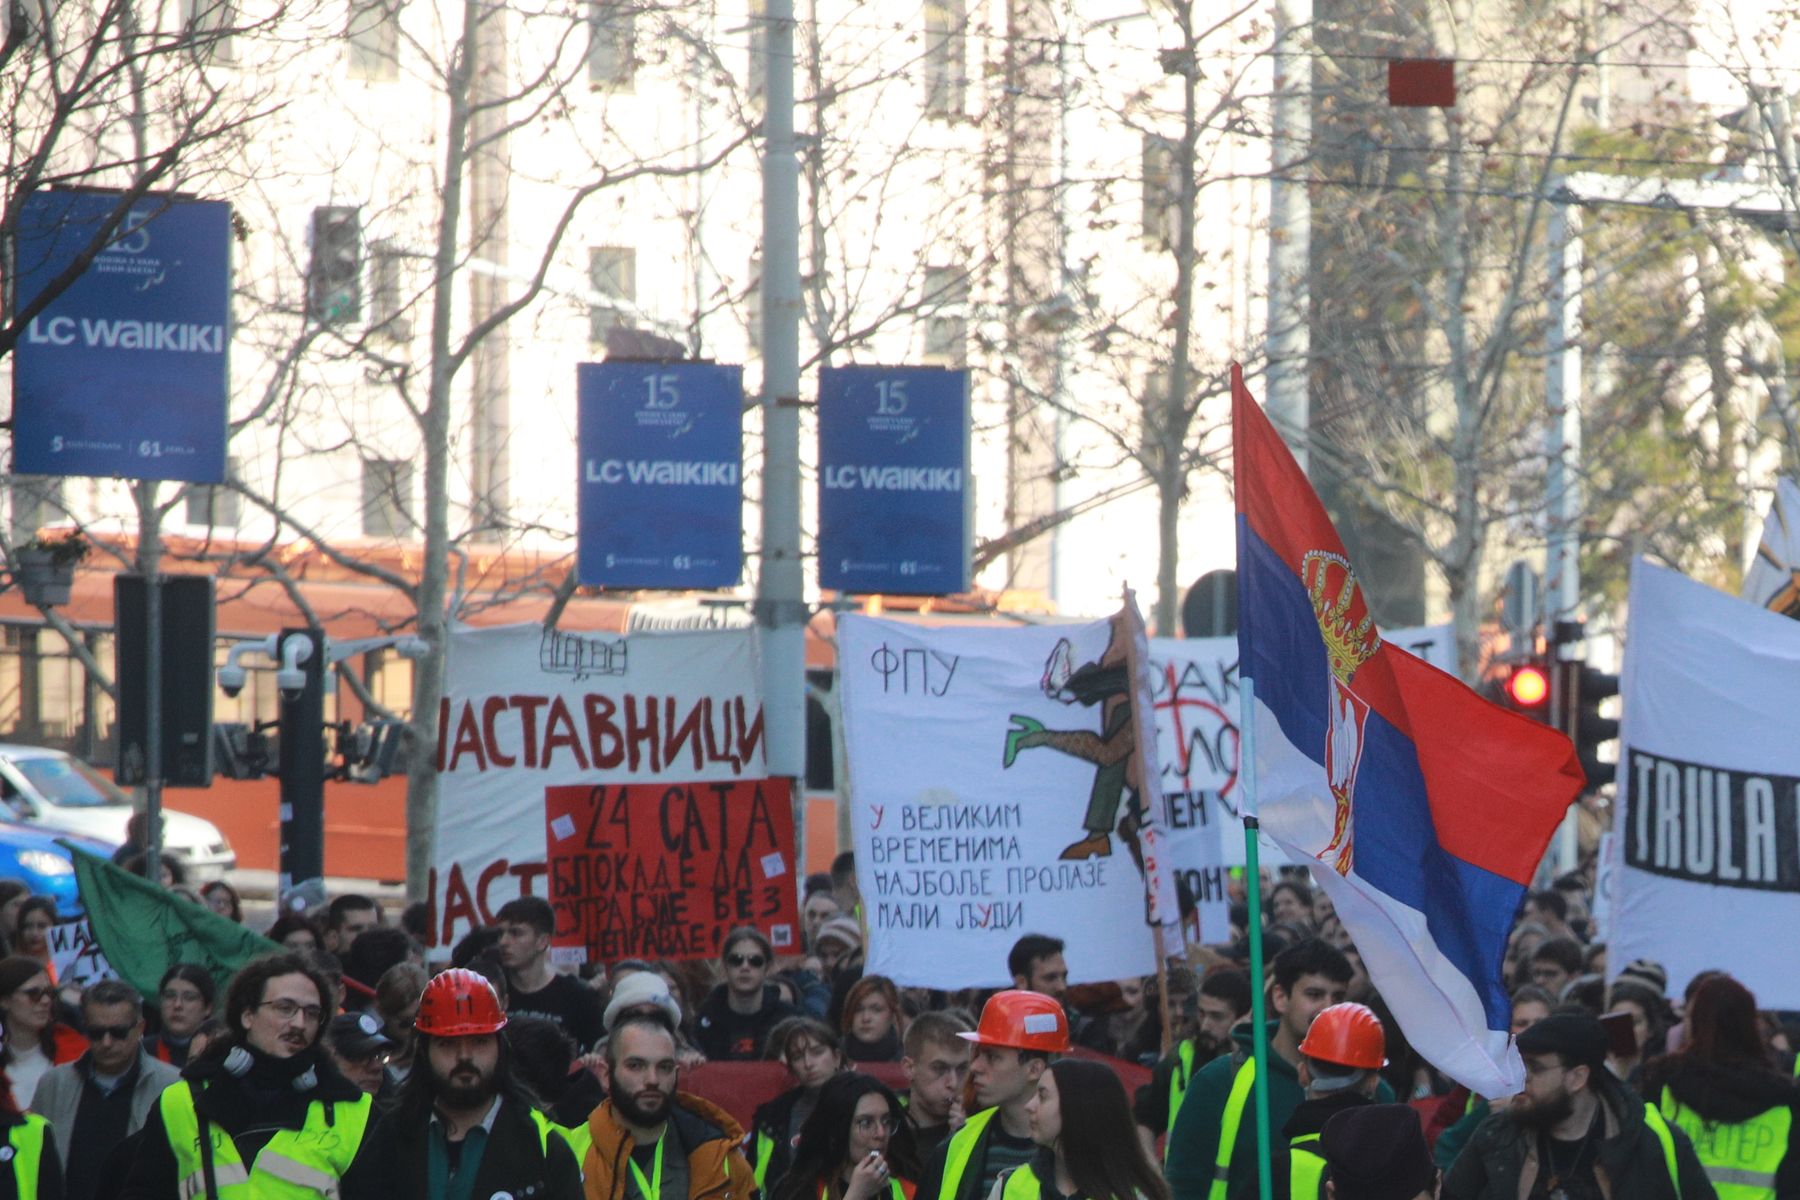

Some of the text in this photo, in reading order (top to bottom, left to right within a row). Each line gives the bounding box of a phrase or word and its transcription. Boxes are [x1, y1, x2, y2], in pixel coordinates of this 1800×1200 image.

[28, 315, 76, 345] LC
[642, 373, 680, 409] 15
[875, 379, 908, 415] 15
[52, 436, 64, 453] 5
[586, 459, 624, 485] LC
[825, 465, 859, 489] LC
[871, 642, 959, 697] ФПУ
[585, 782, 778, 852] 24 САТА
[870, 804, 1022, 831] У ВЕЛИКИМ
[1634, 754, 1779, 883] TRULA
[871, 836, 1021, 864] ВРЕМЕНИМА
[552, 849, 753, 897] БЛОКАДЕ ДА
[874, 861, 1108, 897] НАЈБОЉЕ ПРОЛАЗЕ
[552, 893, 628, 938] СУТРА
[713, 885, 782, 921] БЕЗ
[878, 902, 1024, 931] МАЛИ ЉУДИ
